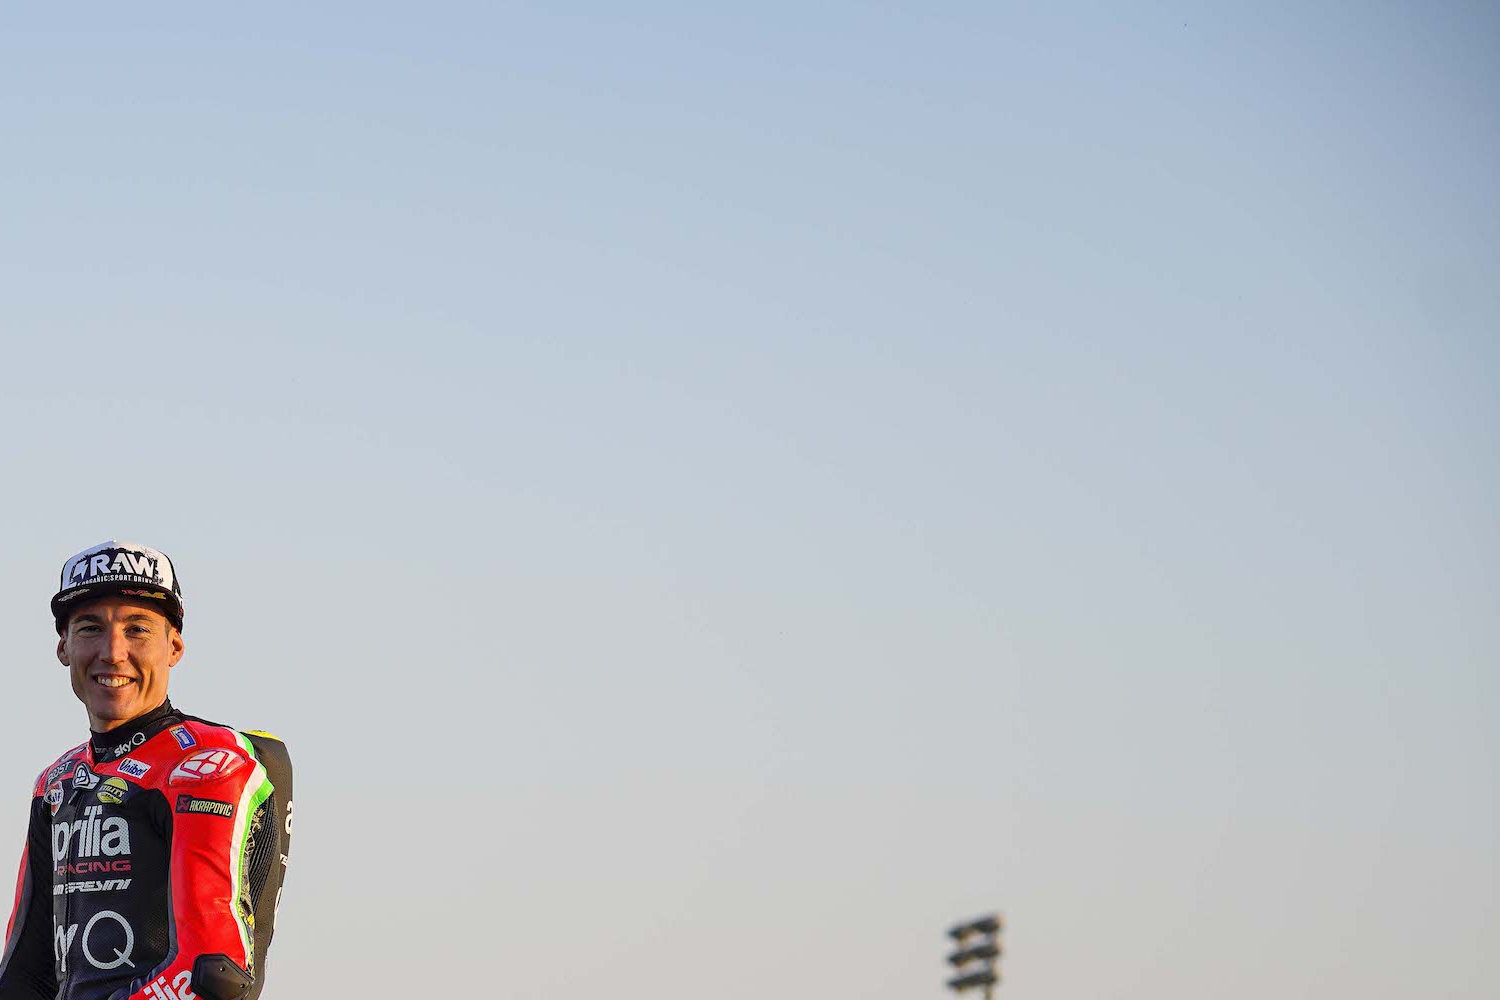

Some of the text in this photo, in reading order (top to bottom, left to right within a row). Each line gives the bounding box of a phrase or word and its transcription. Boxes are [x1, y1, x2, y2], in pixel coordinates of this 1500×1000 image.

[114, 732, 146, 757] sky Q
[82, 910, 135, 970] Q
